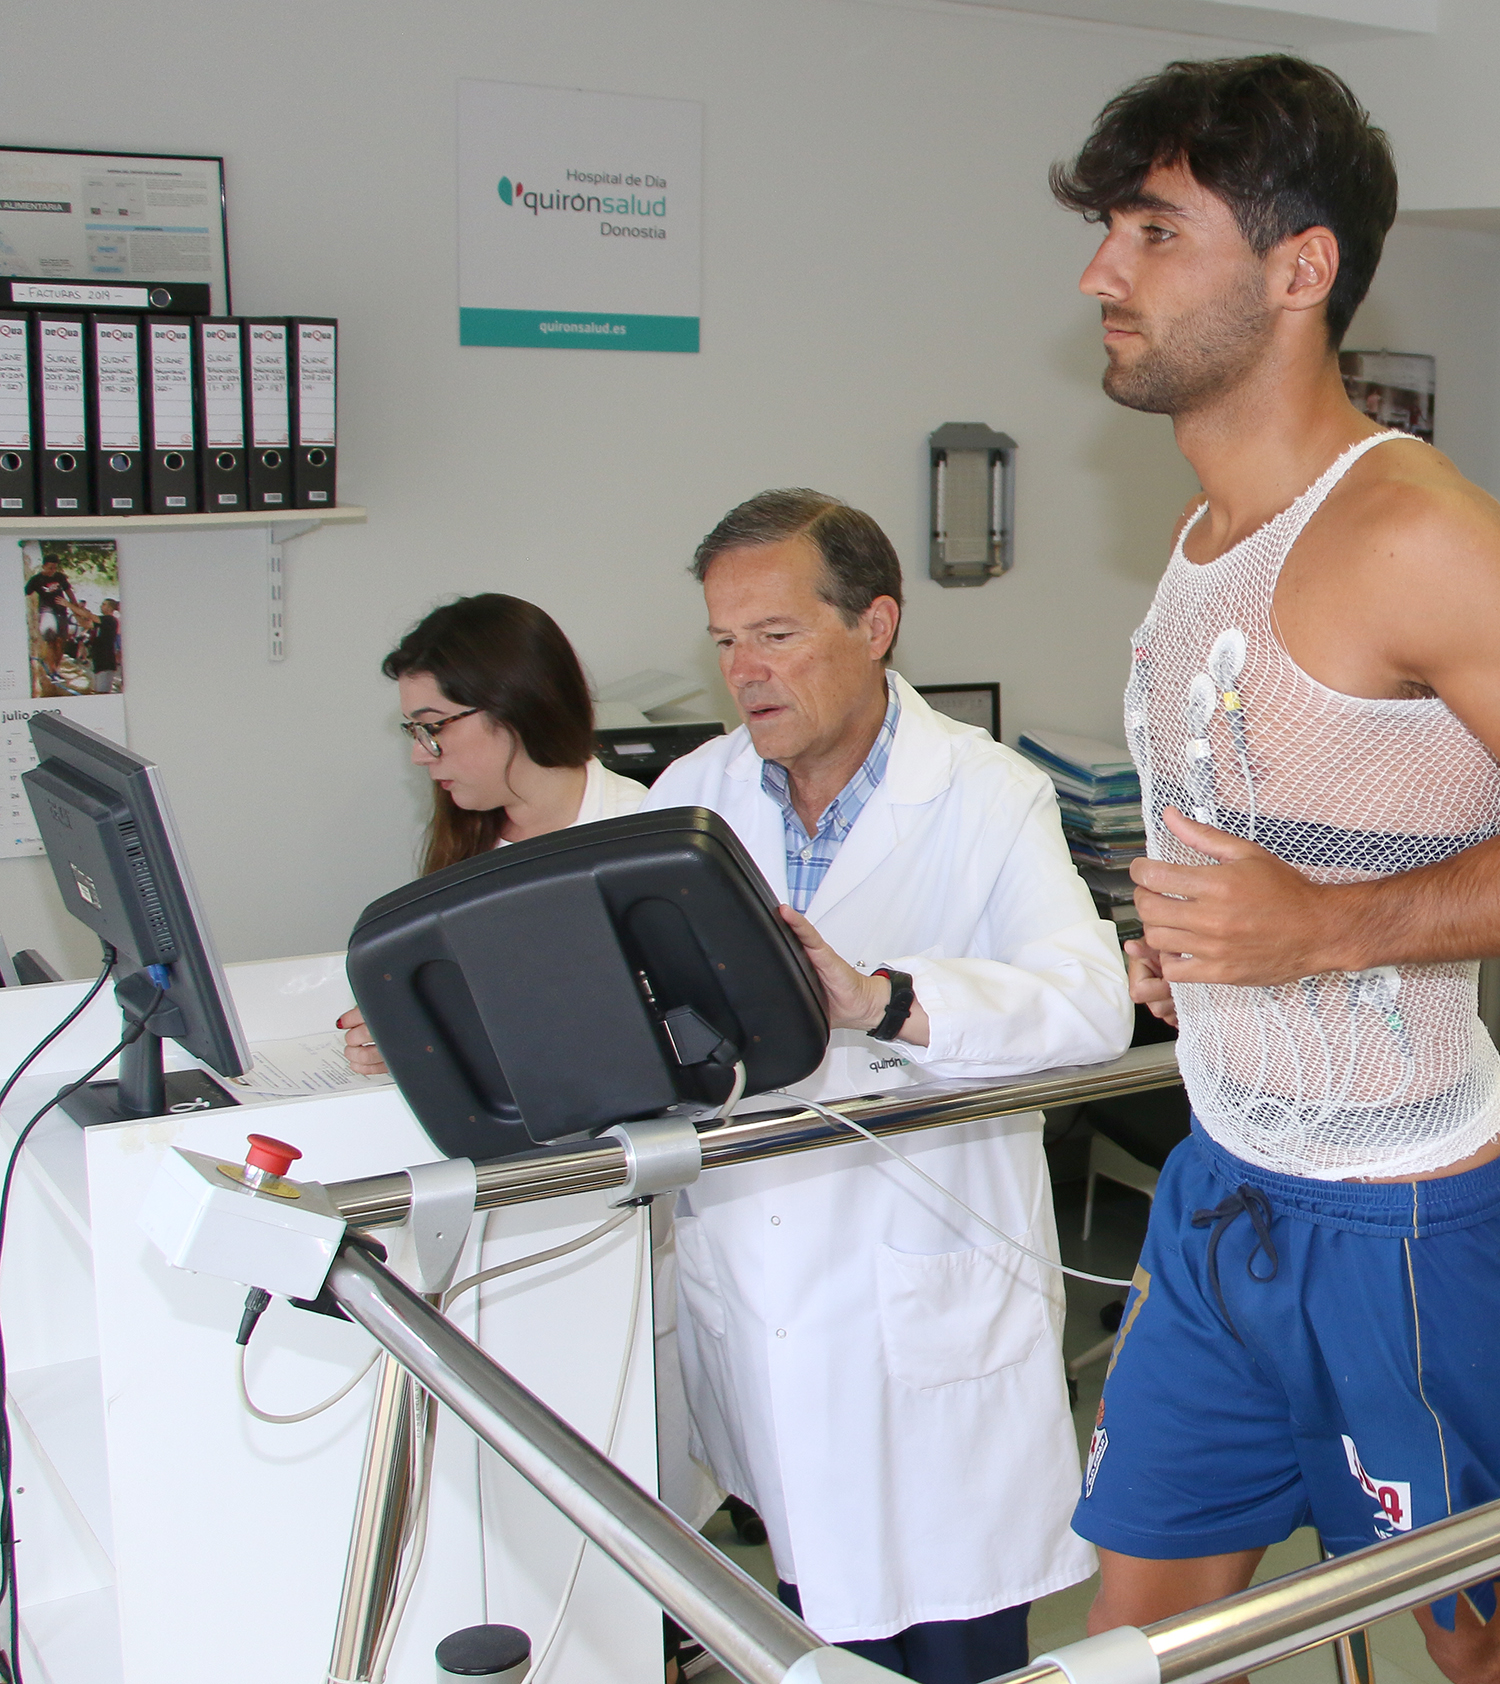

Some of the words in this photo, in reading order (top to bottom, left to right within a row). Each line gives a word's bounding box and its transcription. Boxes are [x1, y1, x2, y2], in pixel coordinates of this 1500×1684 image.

[566, 168, 622, 186] Hospital
[625, 173, 641, 186] de
[3, 201, 64, 211] ALIMENTARIA
[601, 222, 666, 239] Donostia
[28, 287, 81, 299] FACTURAS
[88, 290, 110, 300] 2019
[539, 320, 627, 335] quironsalud.es
[2, 711, 30, 723] julio
